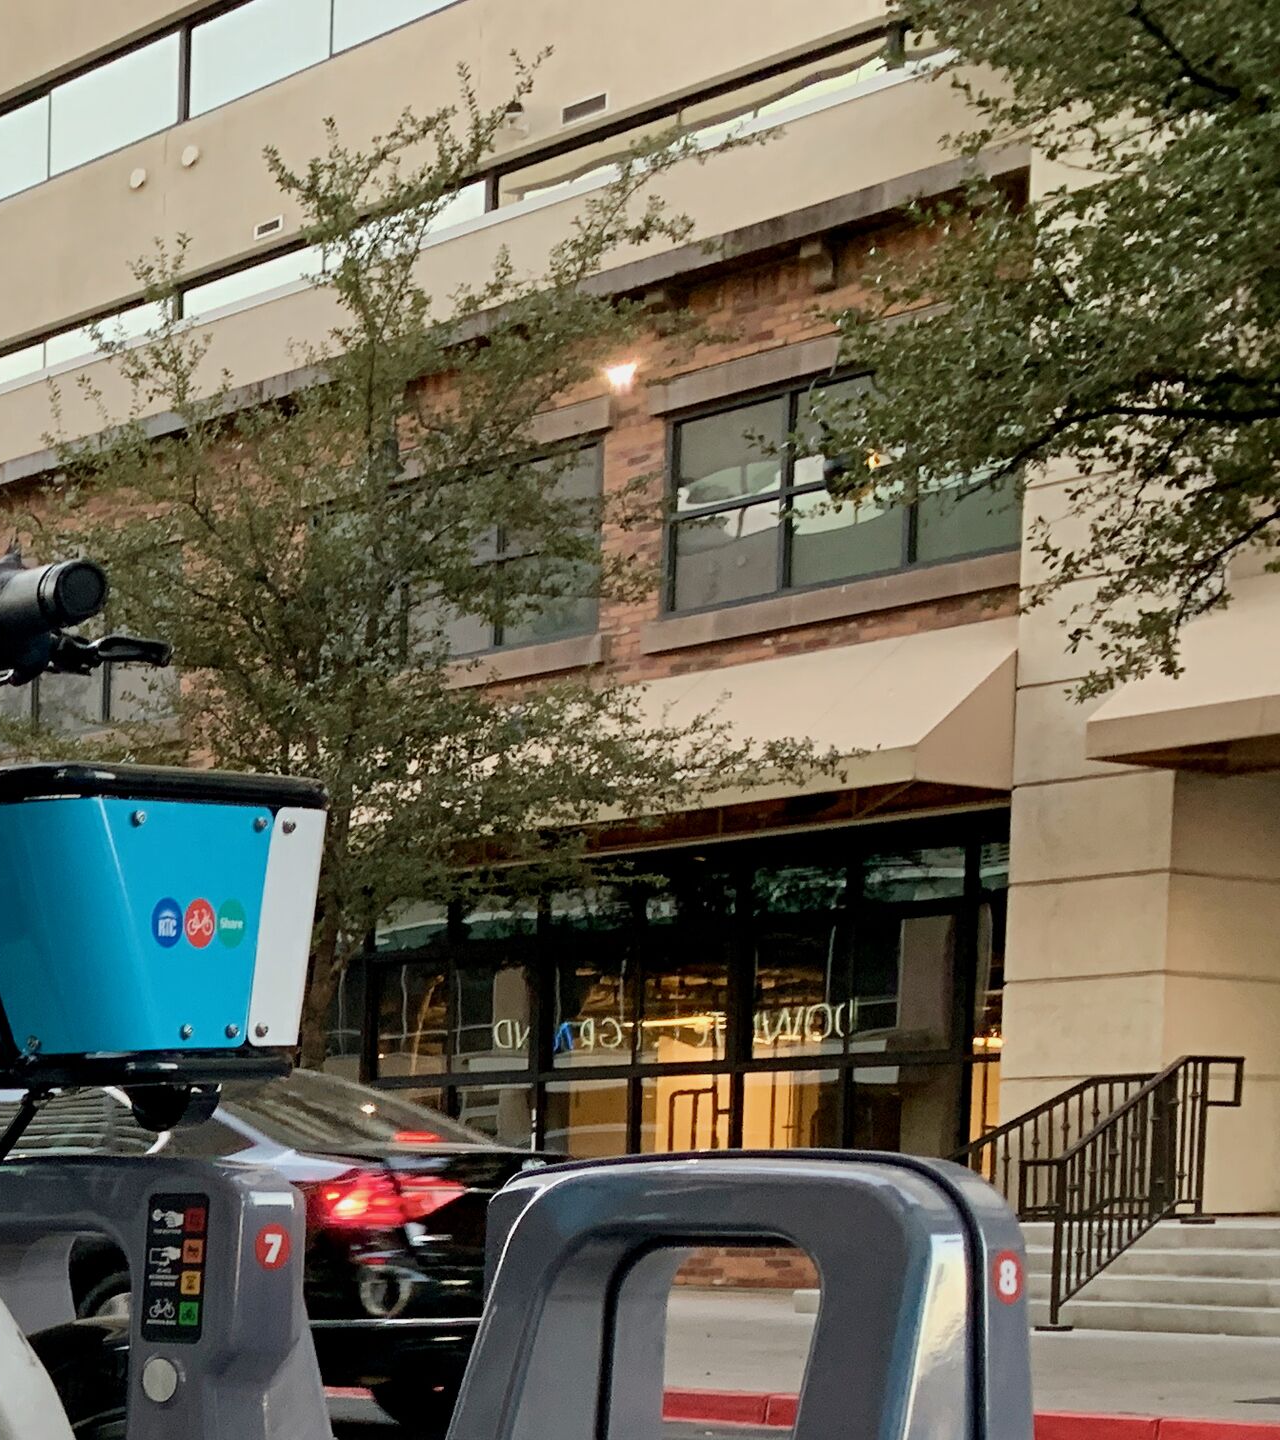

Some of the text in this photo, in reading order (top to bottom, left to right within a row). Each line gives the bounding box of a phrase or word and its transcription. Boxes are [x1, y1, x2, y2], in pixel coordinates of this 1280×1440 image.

[158, 917, 244, 937] RTC Share
[264, 1233, 283, 1264] 7
[999, 1258, 1018, 1296] 8
